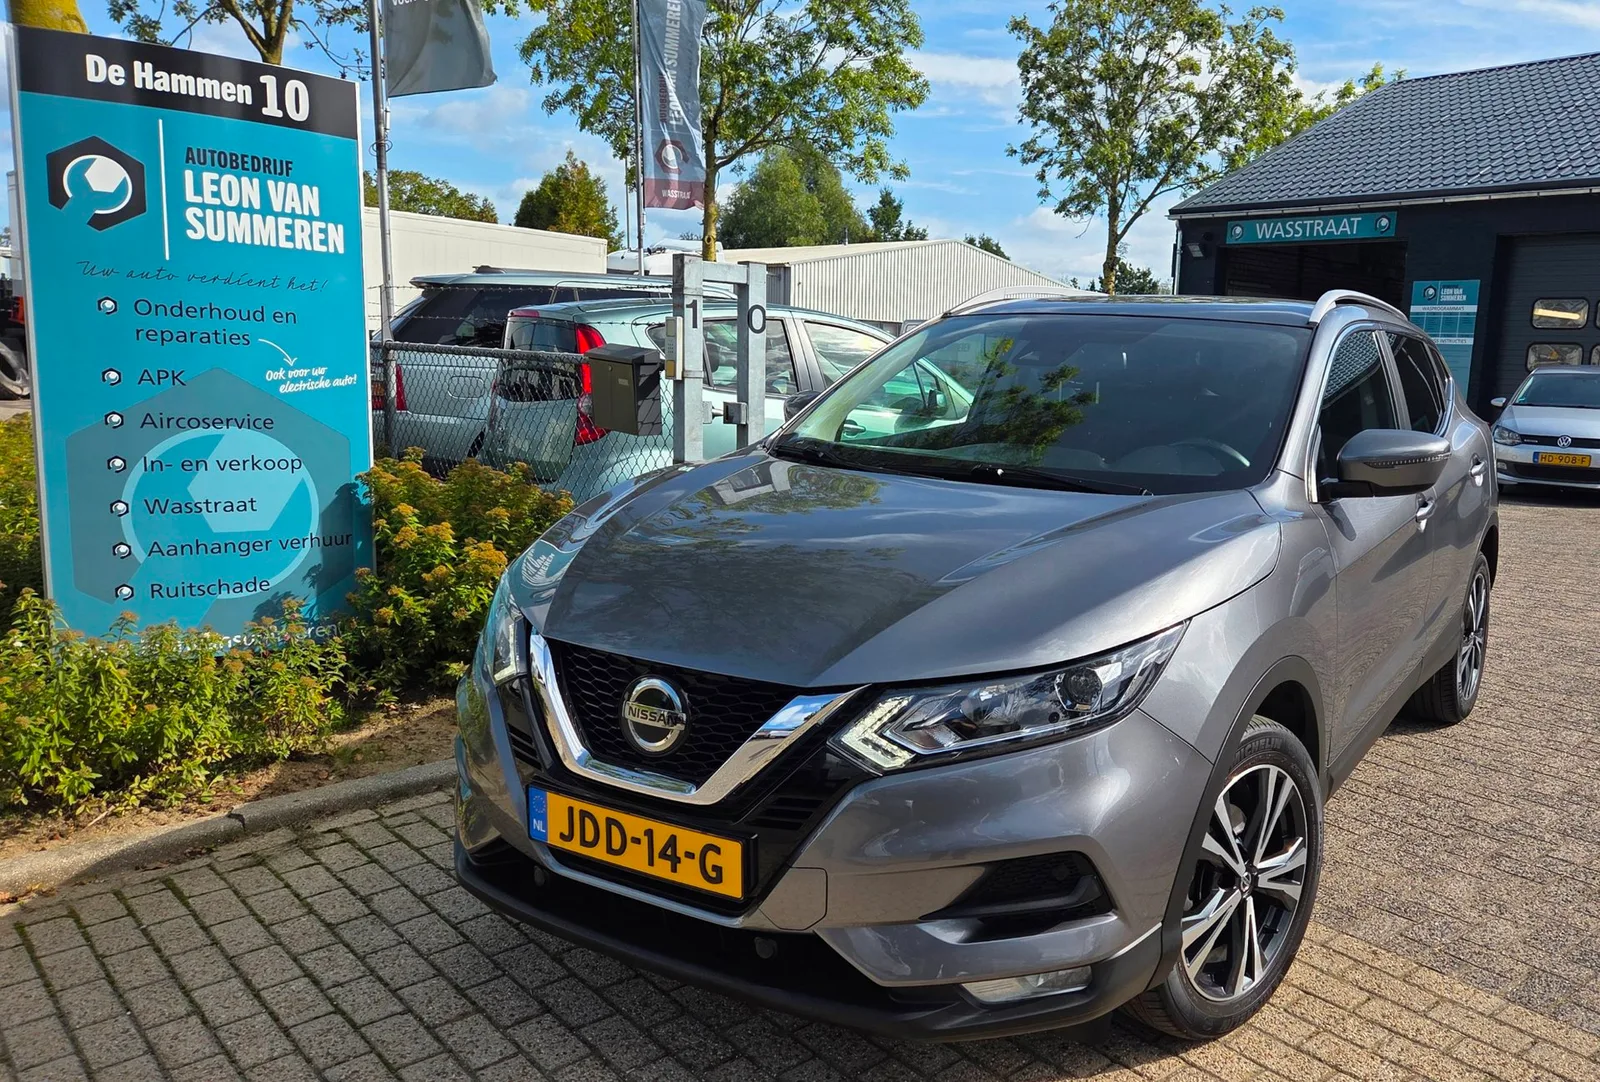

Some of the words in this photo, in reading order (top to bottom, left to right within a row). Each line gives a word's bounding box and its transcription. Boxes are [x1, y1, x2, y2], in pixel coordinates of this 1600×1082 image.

[85, 54, 125, 86] De
[134, 61, 252, 105] Hammen
[259, 75, 310, 122] 10
[185, 146, 293, 178] AUTOBEDRIJF
[184, 170, 261, 210] LEON
[267, 181, 320, 217] VAN
[661, 189, 692, 199] WASSTRAAT
[185, 207, 345, 254] SUMMEREN
[1256, 217, 1362, 239] WASSTRAAT
[76, 260, 119, 277] Uw
[126, 267, 179, 281] auto
[187, 272, 281, 289] verdient
[286, 276, 329, 293] het!
[133, 299, 265, 323] Onderhoud
[272, 309, 297, 325] en
[686, 299, 698, 329] 1
[747, 304, 766, 334] 0
[135, 326, 251, 346] reparaties
[137, 369, 187, 387] APK
[265, 367, 286, 381] Ook
[288, 368, 311, 379] voor
[312, 366, 328, 376] uw
[279, 375, 332, 393] electrische
[332, 373, 357, 387] auto!
[140, 412, 275, 431] Aircoservice
[142, 456, 174, 472] In-
[181, 459, 209, 472] en
[216, 454, 303, 474] verkoop
[144, 497, 258, 516] Wasstraat
[147, 539, 272, 558] Aanhanger
[279, 531, 353, 551] verhuur
[150, 577, 271, 600] Ruitschade
[627, 705, 678, 728] NISSAN
[532, 818, 546, 833] NL
[559, 805, 724, 886] JDD-14-G
